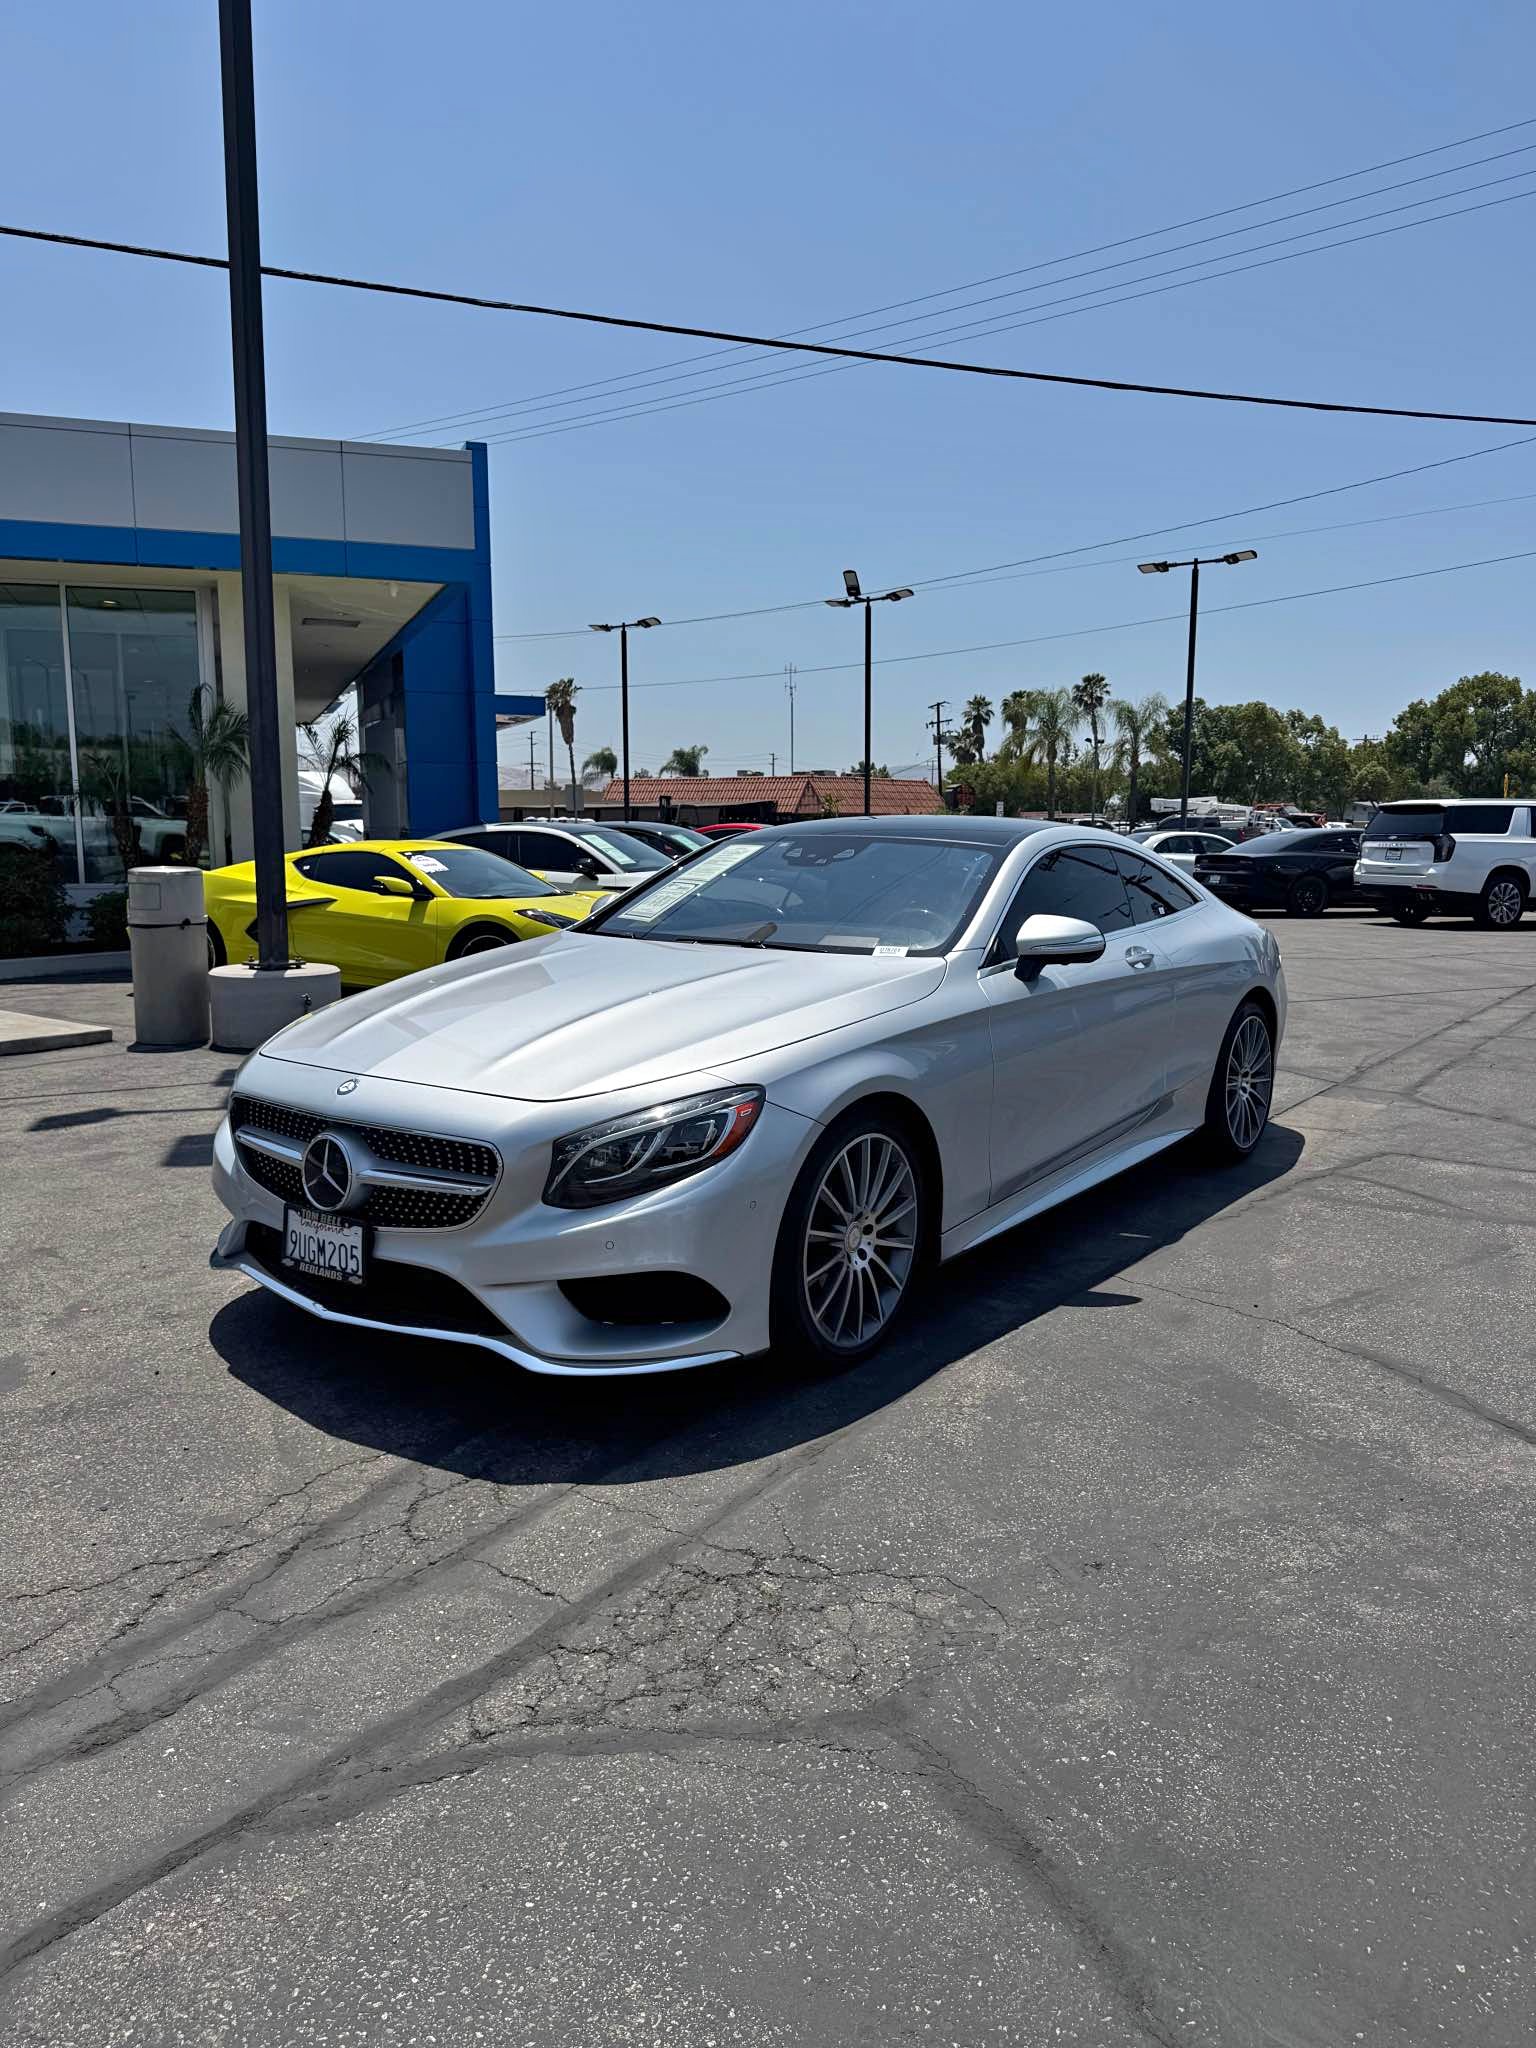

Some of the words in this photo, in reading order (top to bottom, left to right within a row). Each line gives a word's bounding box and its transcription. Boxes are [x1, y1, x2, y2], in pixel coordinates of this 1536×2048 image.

[302, 1208, 320, 1222] TOM
[290, 1229, 360, 1274] 9UGM205
[299, 1262, 343, 1281] REDLANDS
